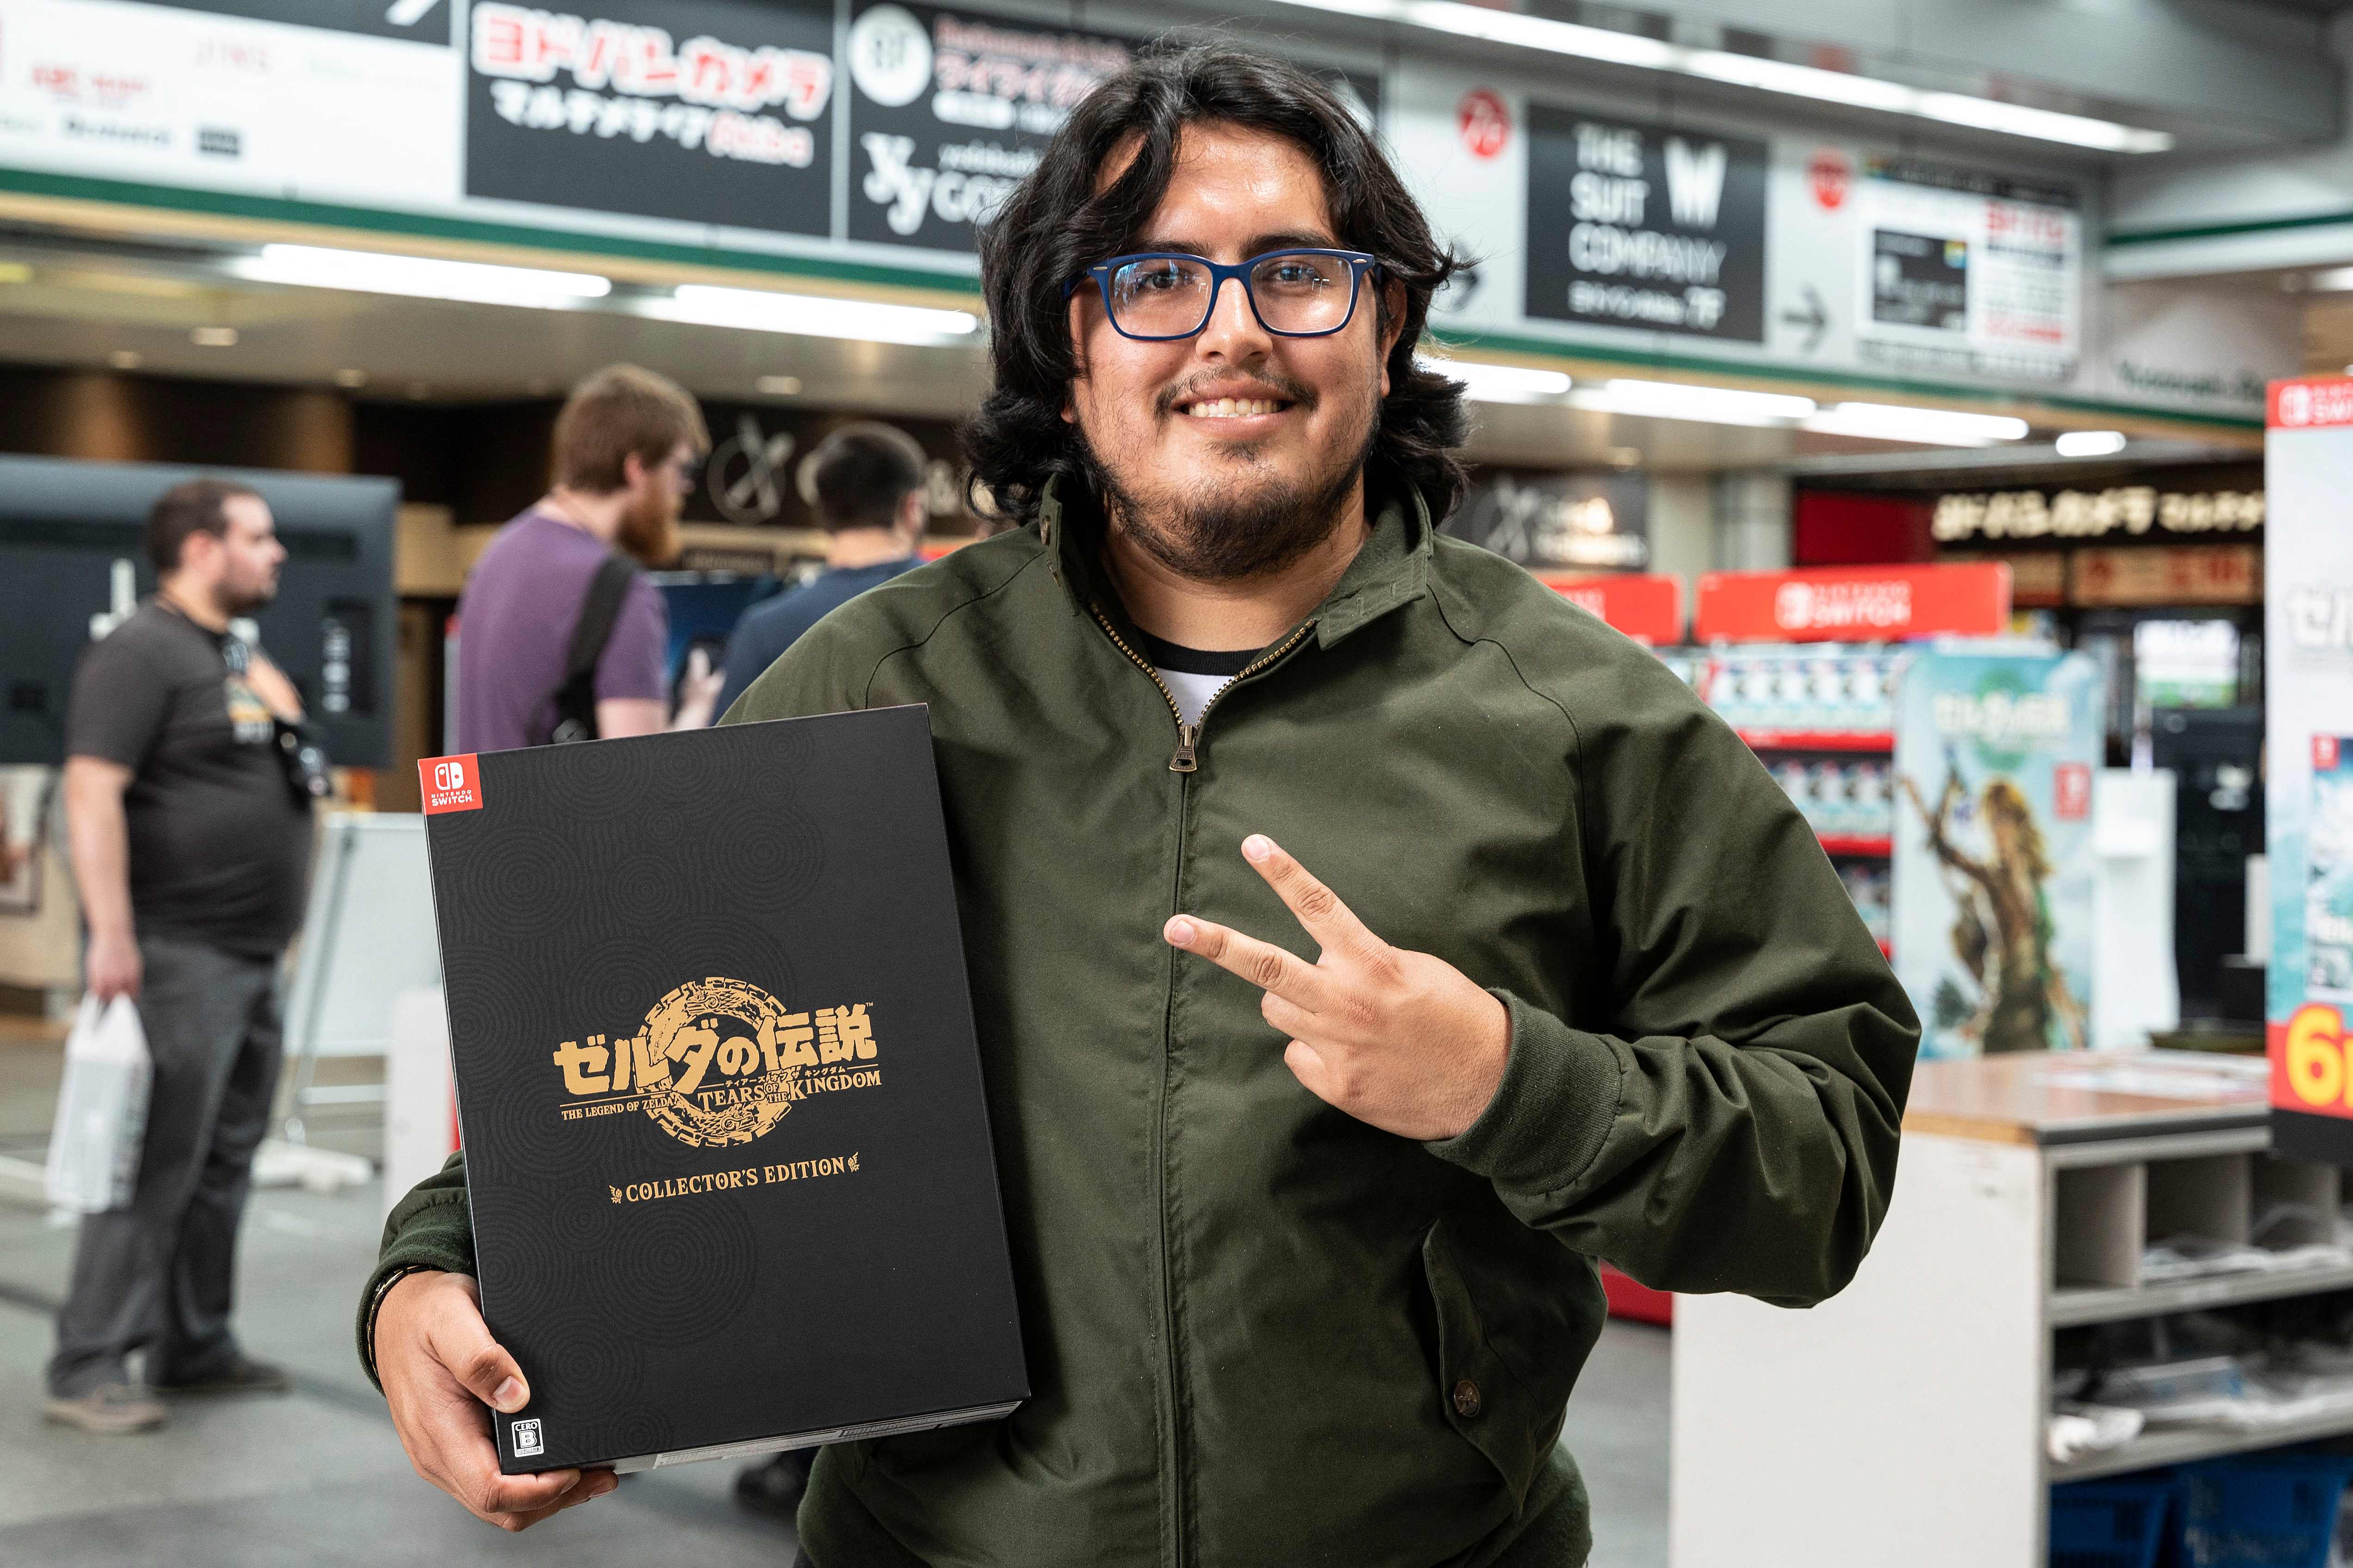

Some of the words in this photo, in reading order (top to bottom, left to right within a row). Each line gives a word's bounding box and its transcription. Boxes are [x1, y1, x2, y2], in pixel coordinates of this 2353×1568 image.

[1576, 123, 1643, 177] THE
[1571, 172, 1648, 227] SUIT
[1569, 223, 1728, 284] COMPANY
[431, 790, 471, 799] NINTENDO
[432, 795, 472, 807] SWITCH
[553, 1003, 878, 1095] ゼルダの伝説
[805, 1066, 846, 1077] キングダム
[766, 1083, 779, 1093] OF
[787, 1070, 882, 1100] KINGDOM
[562, 1109, 583, 1120] THE
[585, 1104, 624, 1117] LEGEND
[626, 1101, 639, 1111] OF
[642, 1097, 674, 1110] ZELDA
[697, 1085, 765, 1112] TEARS
[767, 1093, 788, 1103] THE
[626, 1168, 758, 1202] COLLECTOR'S
[763, 1157, 845, 1184] EDITION
[515, 1422, 538, 1431] CERO
[519, 1430, 537, 1448] B
